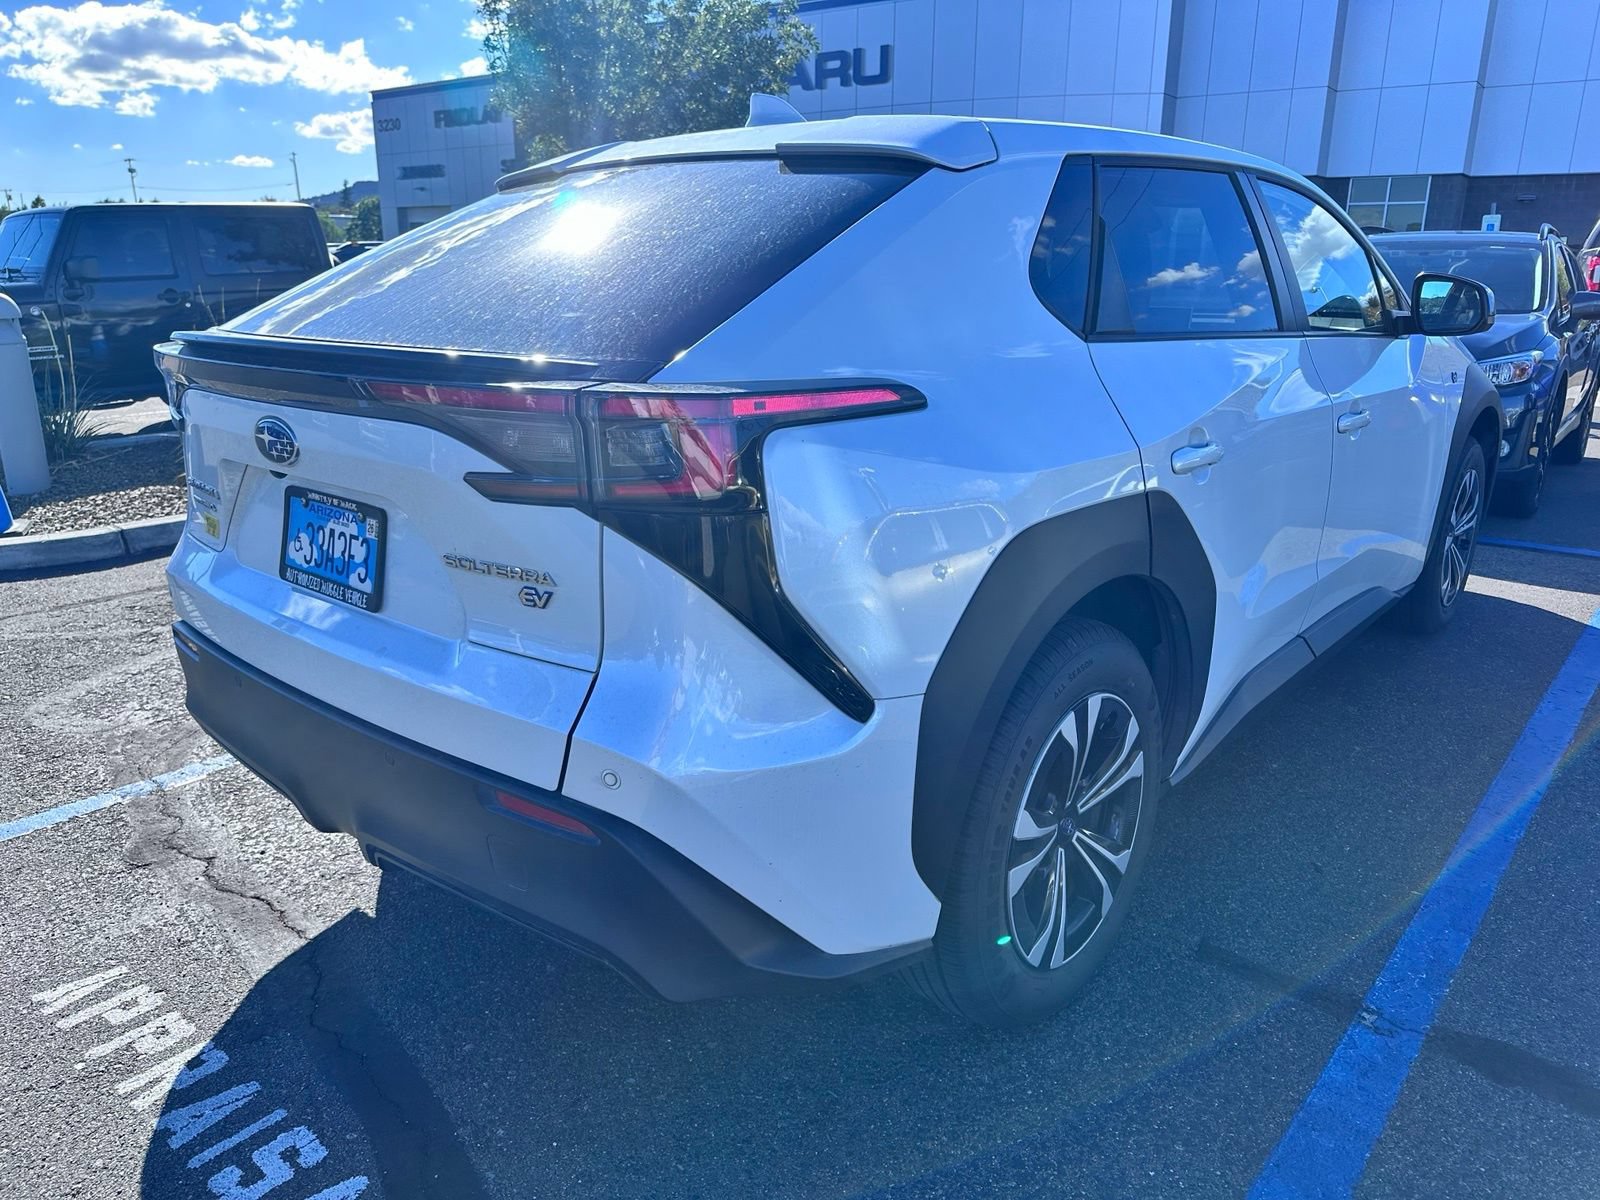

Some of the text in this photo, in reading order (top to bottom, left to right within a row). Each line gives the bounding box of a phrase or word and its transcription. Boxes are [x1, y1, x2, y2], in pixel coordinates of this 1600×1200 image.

[377, 118, 401, 132] 3230
[309, 503, 358, 525] ARIZONA
[303, 522, 370, 583] 33A3F3
[442, 552, 558, 587] SOLTERRA
[519, 585, 554, 609] EV
[1054, 659, 1094, 700] ALL SEASON
